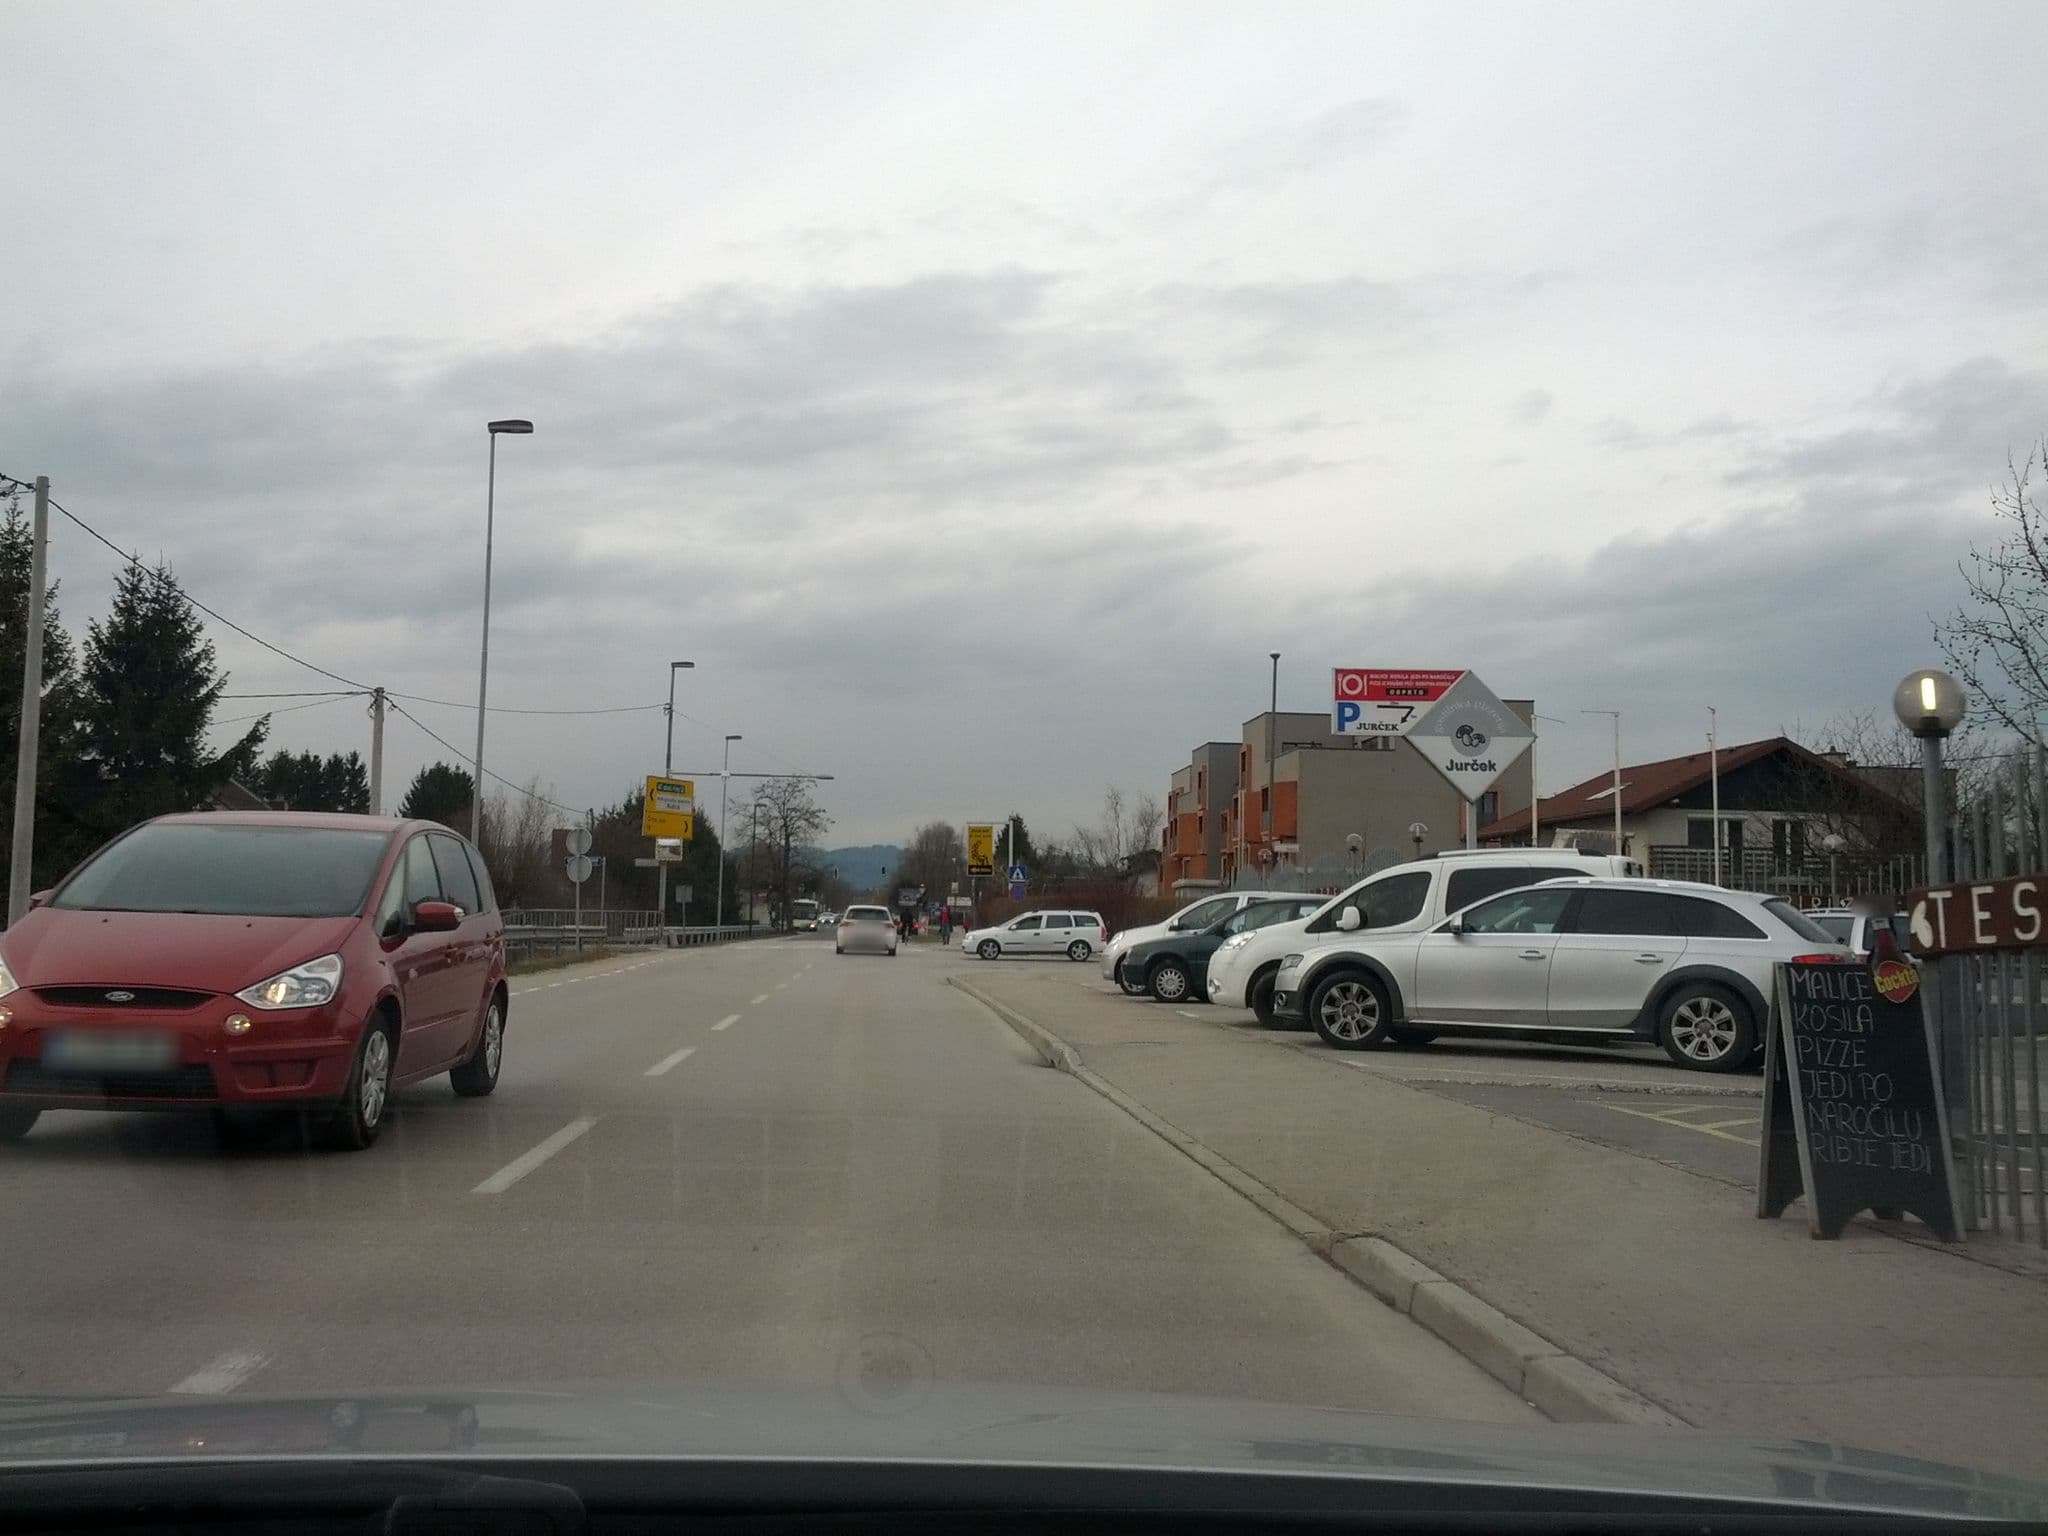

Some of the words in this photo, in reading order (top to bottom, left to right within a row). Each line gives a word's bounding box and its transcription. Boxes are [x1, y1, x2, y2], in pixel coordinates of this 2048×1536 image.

[1337, 702, 1360, 732] P
[1356, 721, 1399, 731] JURČEK
[1446, 759, 1497, 773] Jurček
[1928, 882, 2041, 949] TES
[1790, 968, 1872, 1000] MALICE
[1794, 1002, 1874, 1032] KOSILA
[1797, 1036, 1866, 1067] PIZZE
[1800, 1069, 1853, 1099] JEDI
[1858, 1073, 1893, 1102] PO
[1807, 1101, 1922, 1140] NAROČILU
[1810, 1132, 1880, 1167] RIBJE
